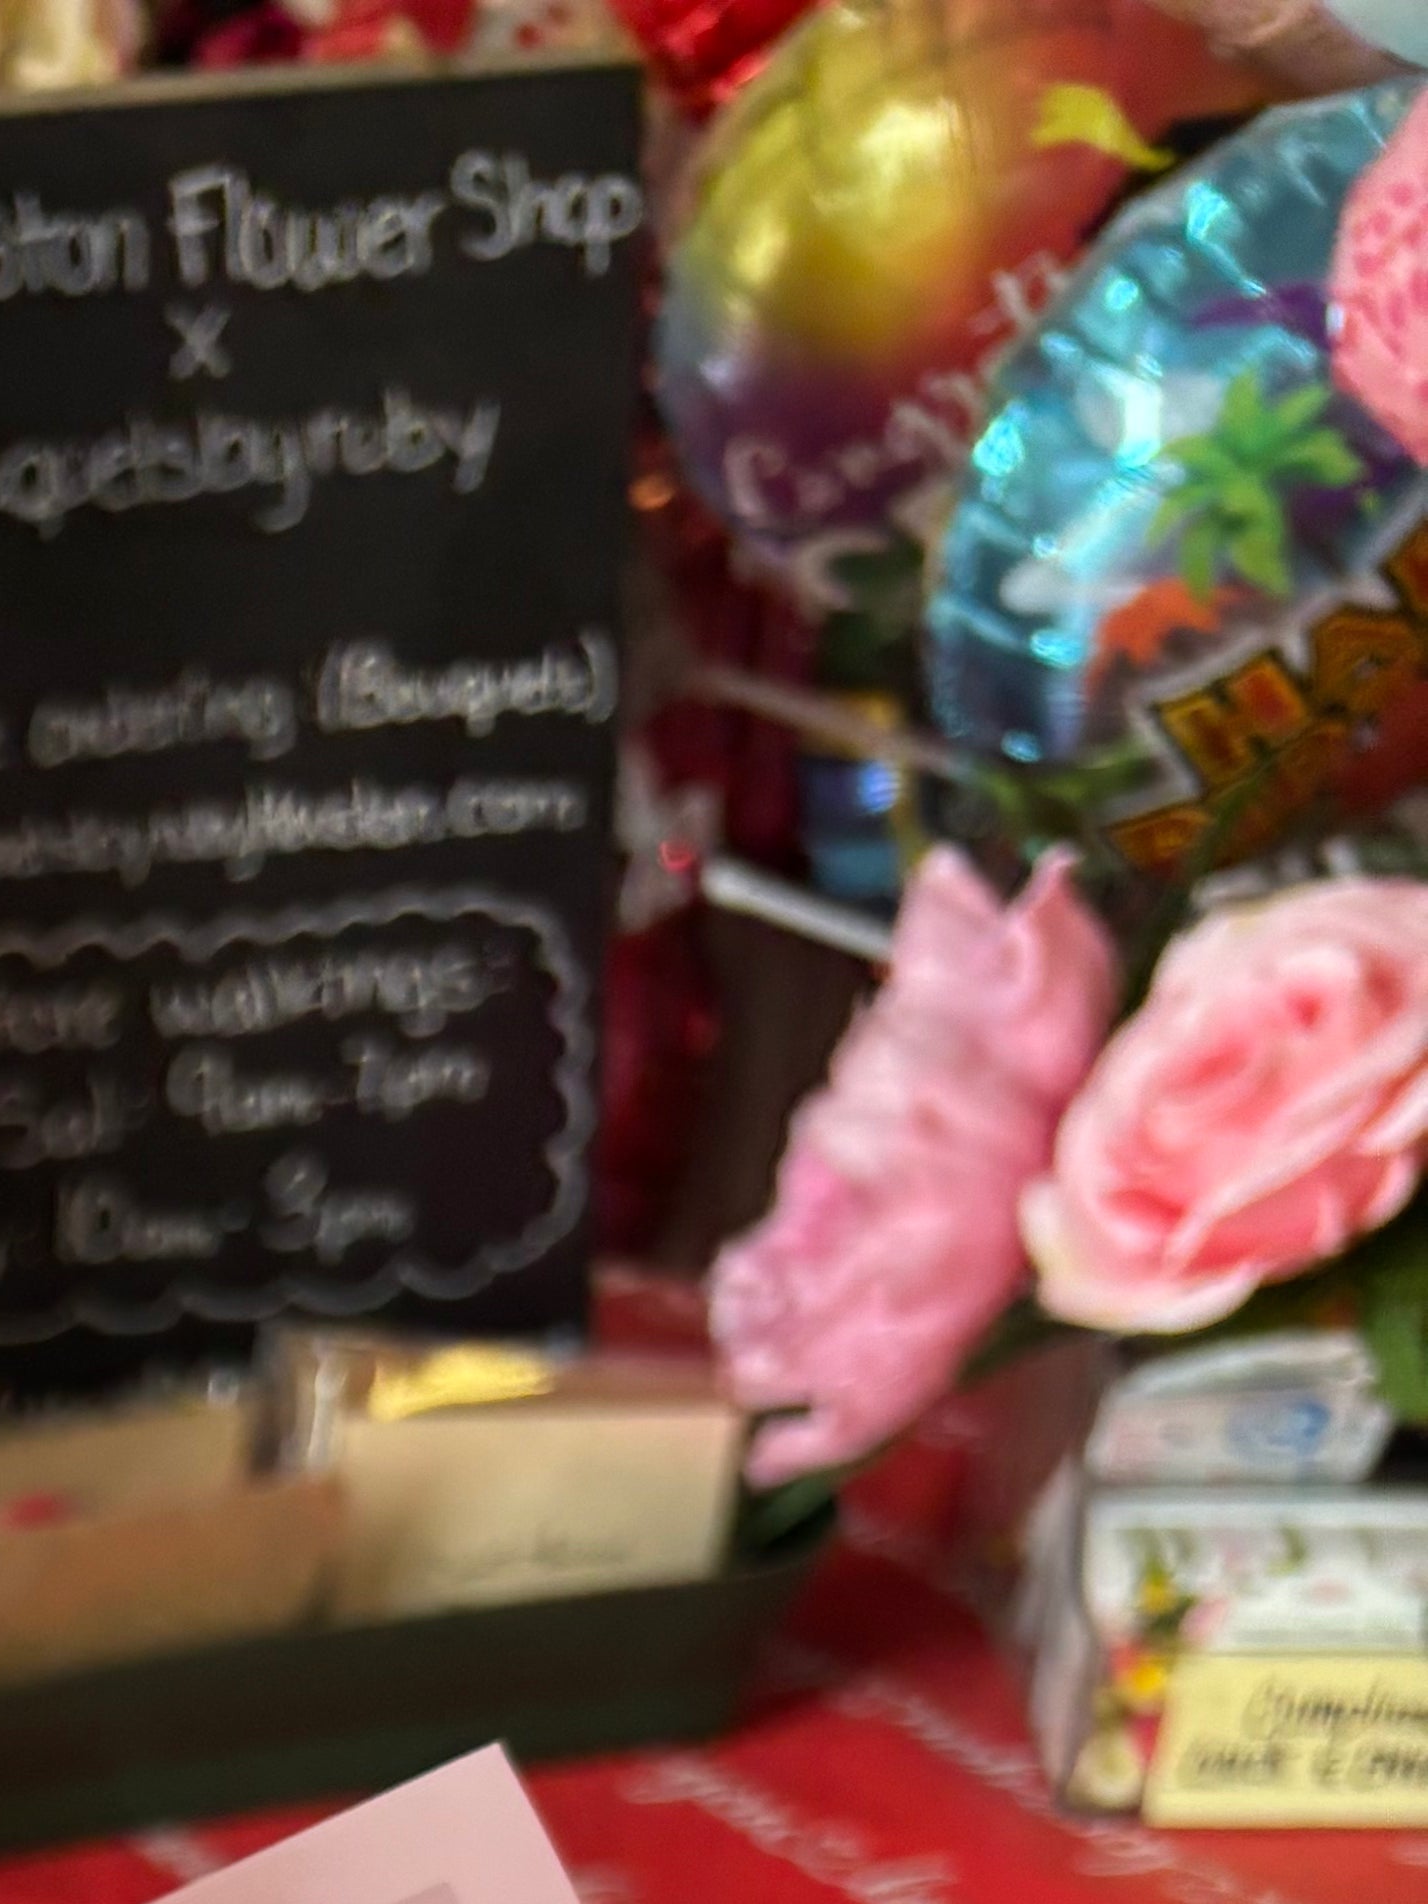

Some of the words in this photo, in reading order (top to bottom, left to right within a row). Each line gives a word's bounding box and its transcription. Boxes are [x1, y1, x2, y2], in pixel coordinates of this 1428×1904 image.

[166, 160, 444, 290] Flower
[449, 147, 644, 276] Shop
[29, 664, 295, 763] ordering
